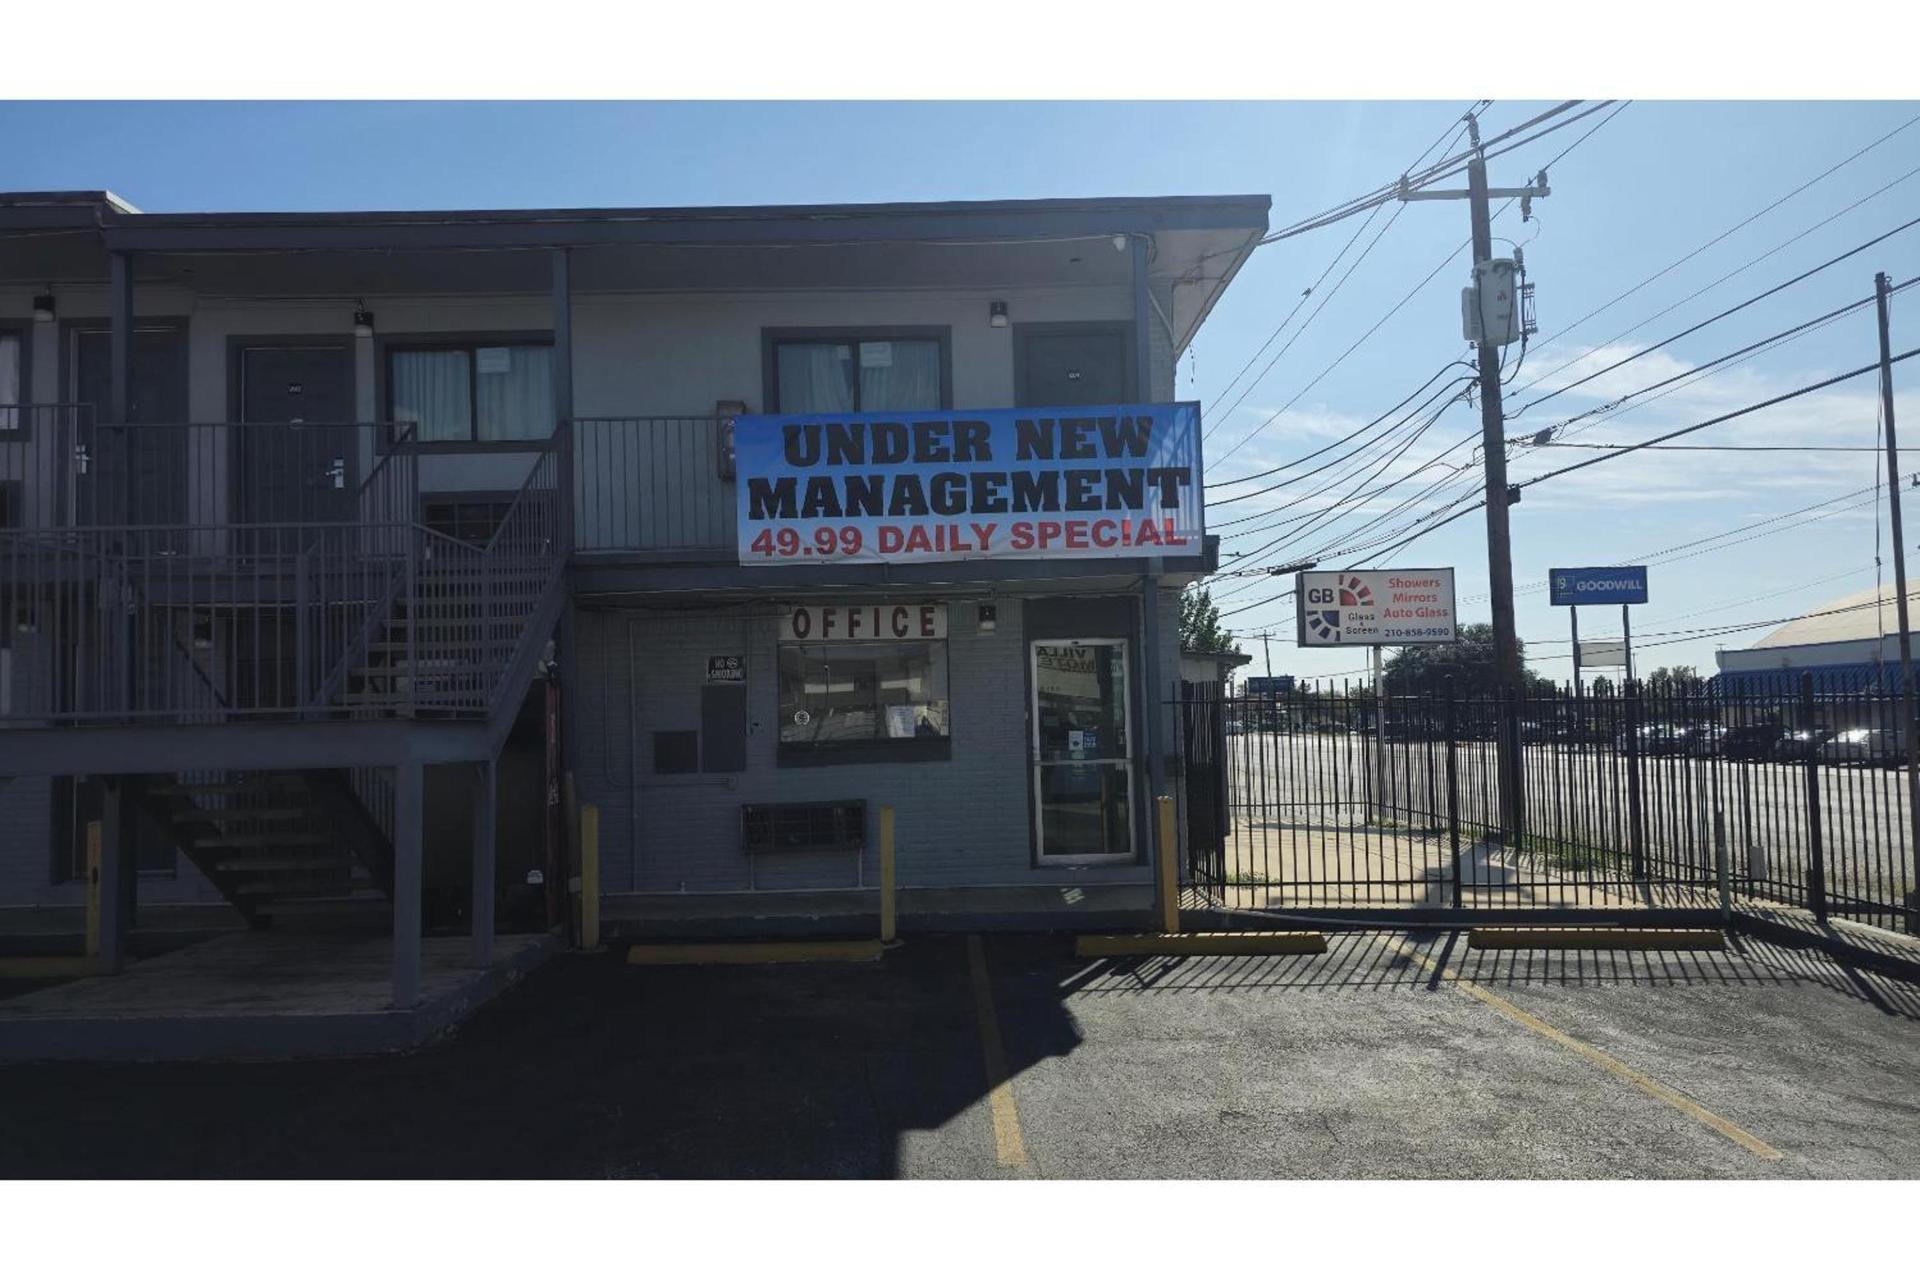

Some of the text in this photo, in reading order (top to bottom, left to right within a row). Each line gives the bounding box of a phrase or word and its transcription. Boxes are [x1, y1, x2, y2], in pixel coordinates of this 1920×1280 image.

[783, 416, 1154, 467] UNDER NEW
[747, 467, 1191, 520] MANAGEMENT
[751, 518, 1187, 557] 49.99 DAILY SPECIAL
[1388, 577, 1441, 589] Showers
[1577, 580, 1642, 591] GOODWILL
[1308, 588, 1334, 604] GB
[1392, 592, 1438, 603] Mirrors
[1384, 606, 1449, 619] Auto Glass
[792, 605, 936, 640] OFFICE
[1346, 627, 1379, 635] Screen
